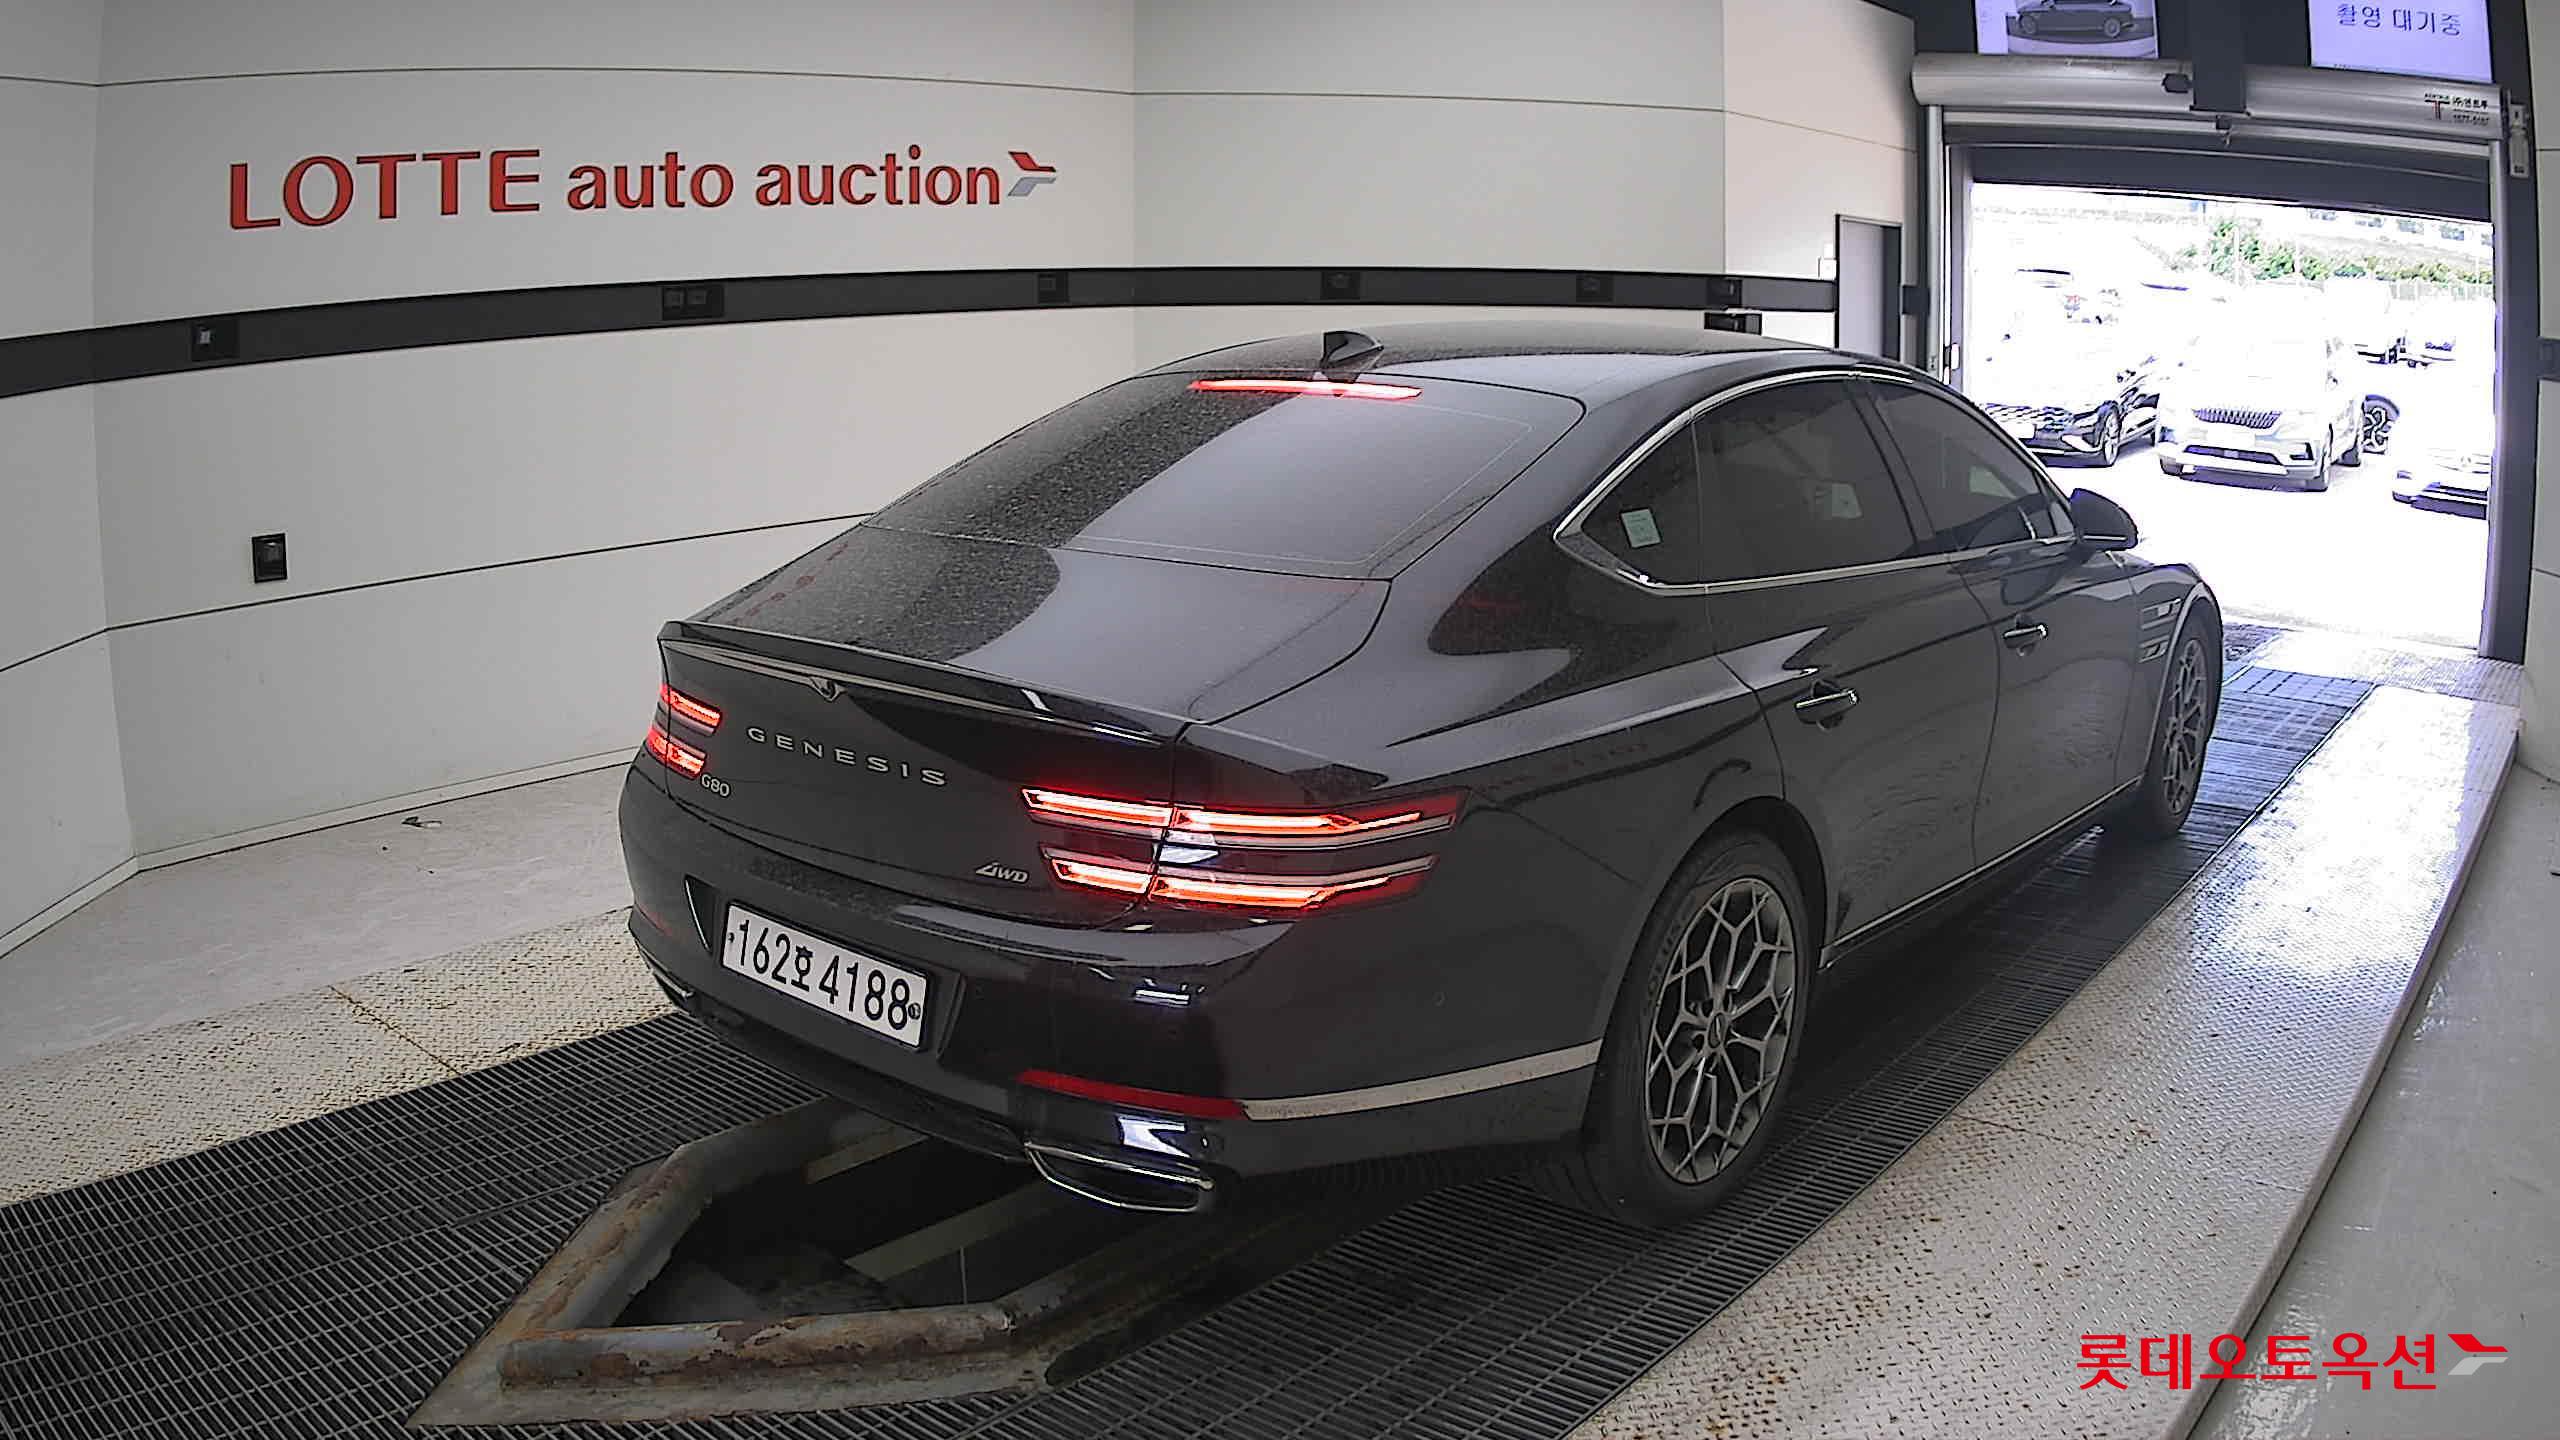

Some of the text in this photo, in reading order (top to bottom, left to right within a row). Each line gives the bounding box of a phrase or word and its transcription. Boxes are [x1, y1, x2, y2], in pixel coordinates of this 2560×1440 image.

[2337, 3, 2461, 36] 촬영 대기중
[229, 144, 1001, 230] LOTTE auto auction
[747, 726, 945, 786] GENESIS
[701, 774, 730, 797] G80
